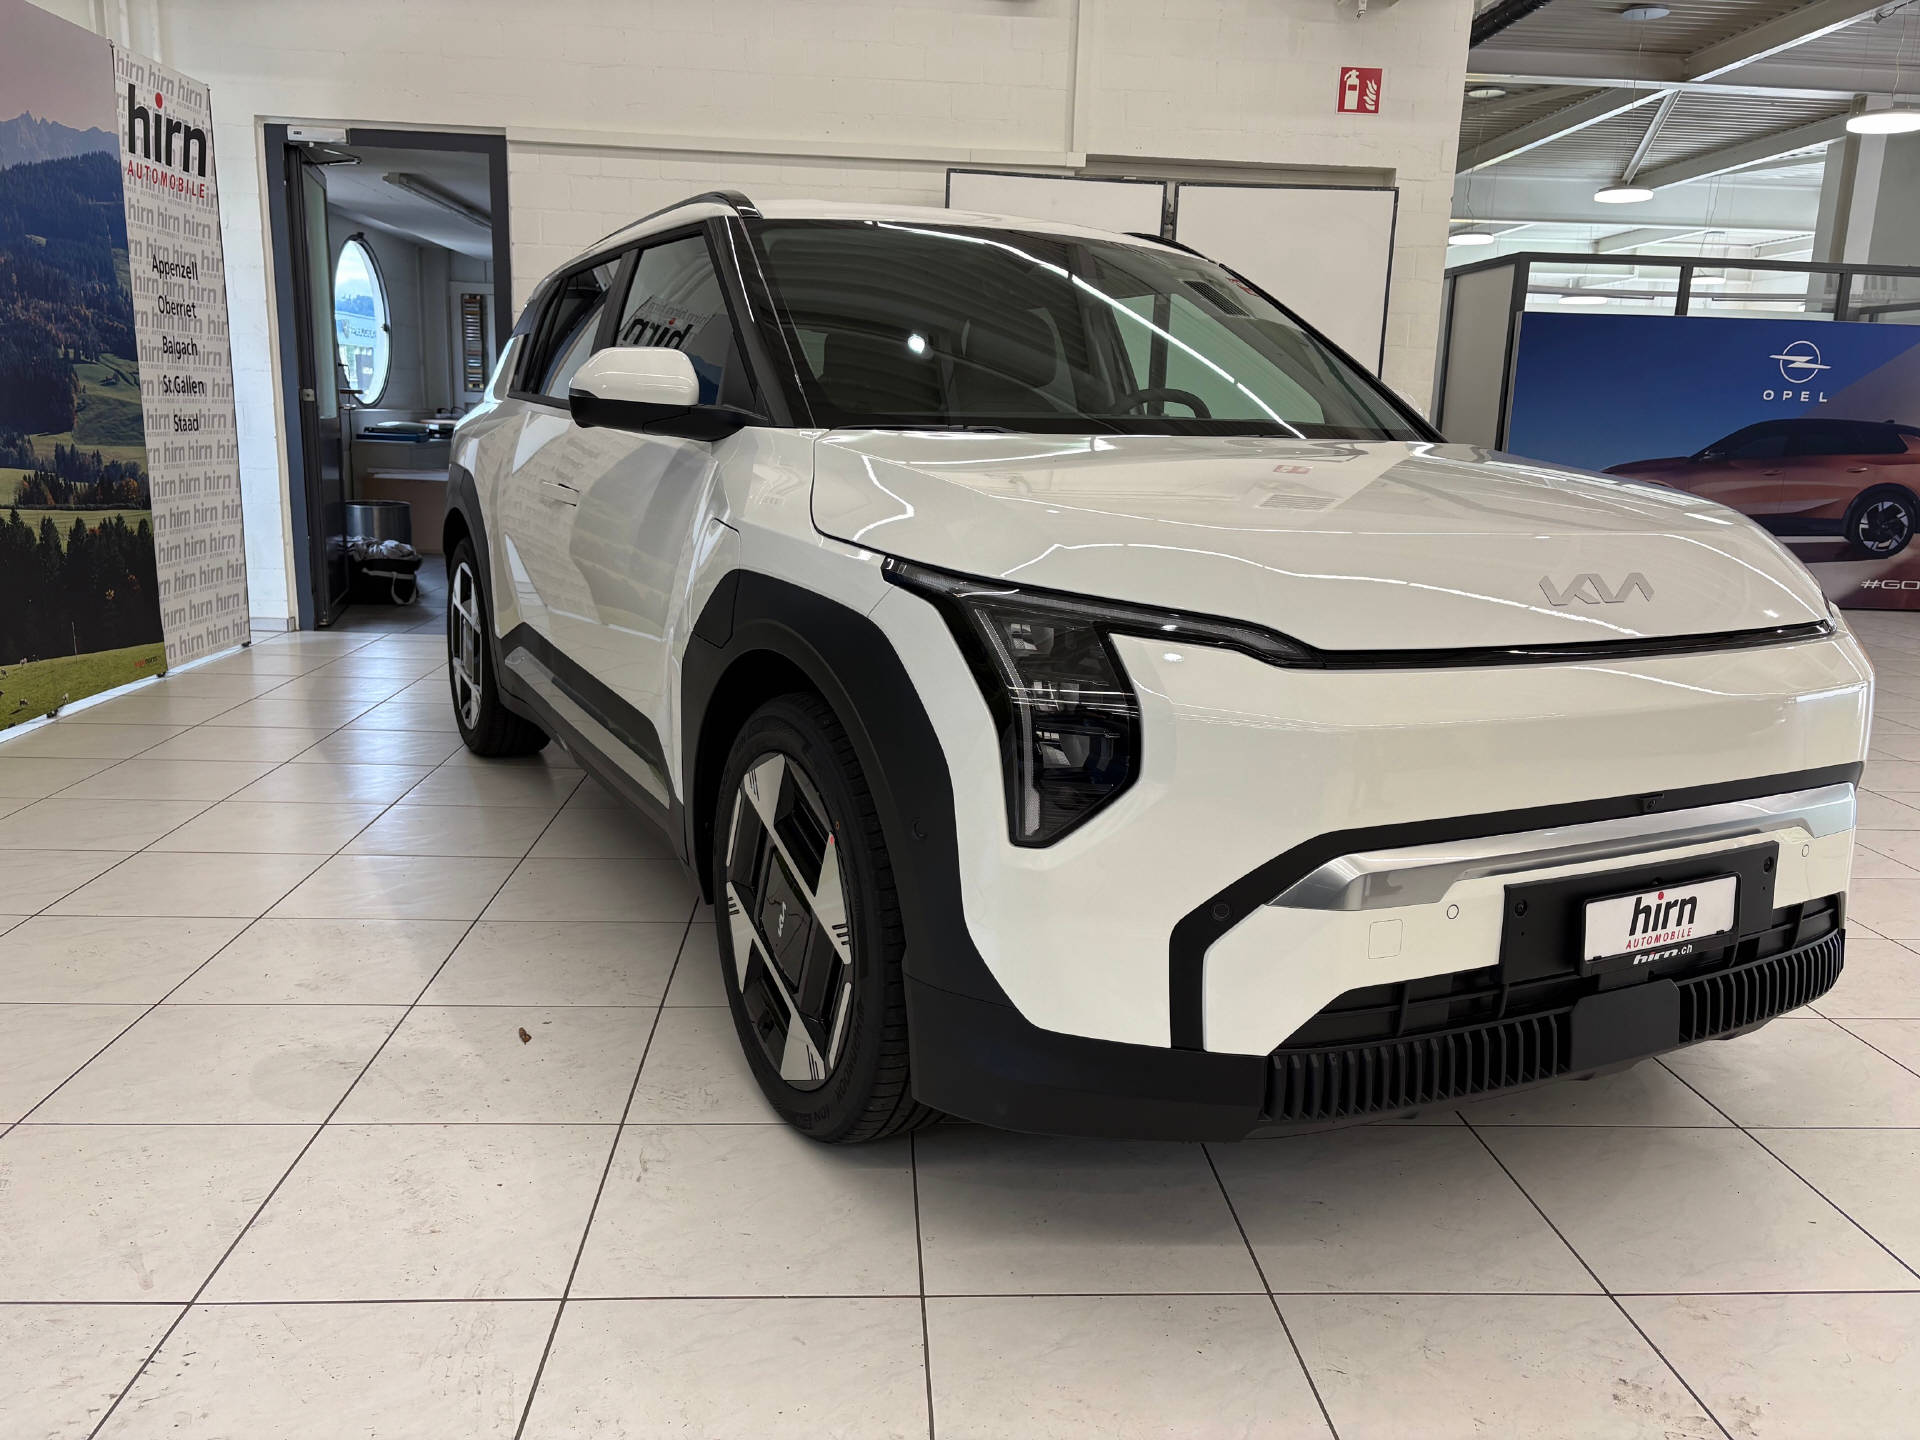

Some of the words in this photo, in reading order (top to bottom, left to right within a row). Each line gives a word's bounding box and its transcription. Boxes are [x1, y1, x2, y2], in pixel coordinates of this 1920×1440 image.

[128, 83, 206, 177] hirn
[127, 160, 205, 198] AUTOMOBILE
[152, 254, 198, 280] Appenzell
[158, 295, 197, 319] Oberriet
[162, 335, 198, 359] Balgach
[163, 374, 205, 394] St.Gallen
[1763, 390, 1828, 403] OPEL
[173, 413, 199, 432] Staad
[1538, 572, 1655, 606] KIA
[1629, 891, 1698, 937] hirn
[1625, 927, 1693, 950] AUTOMOBILE
[1632, 944, 1693, 965] hirn.ch
